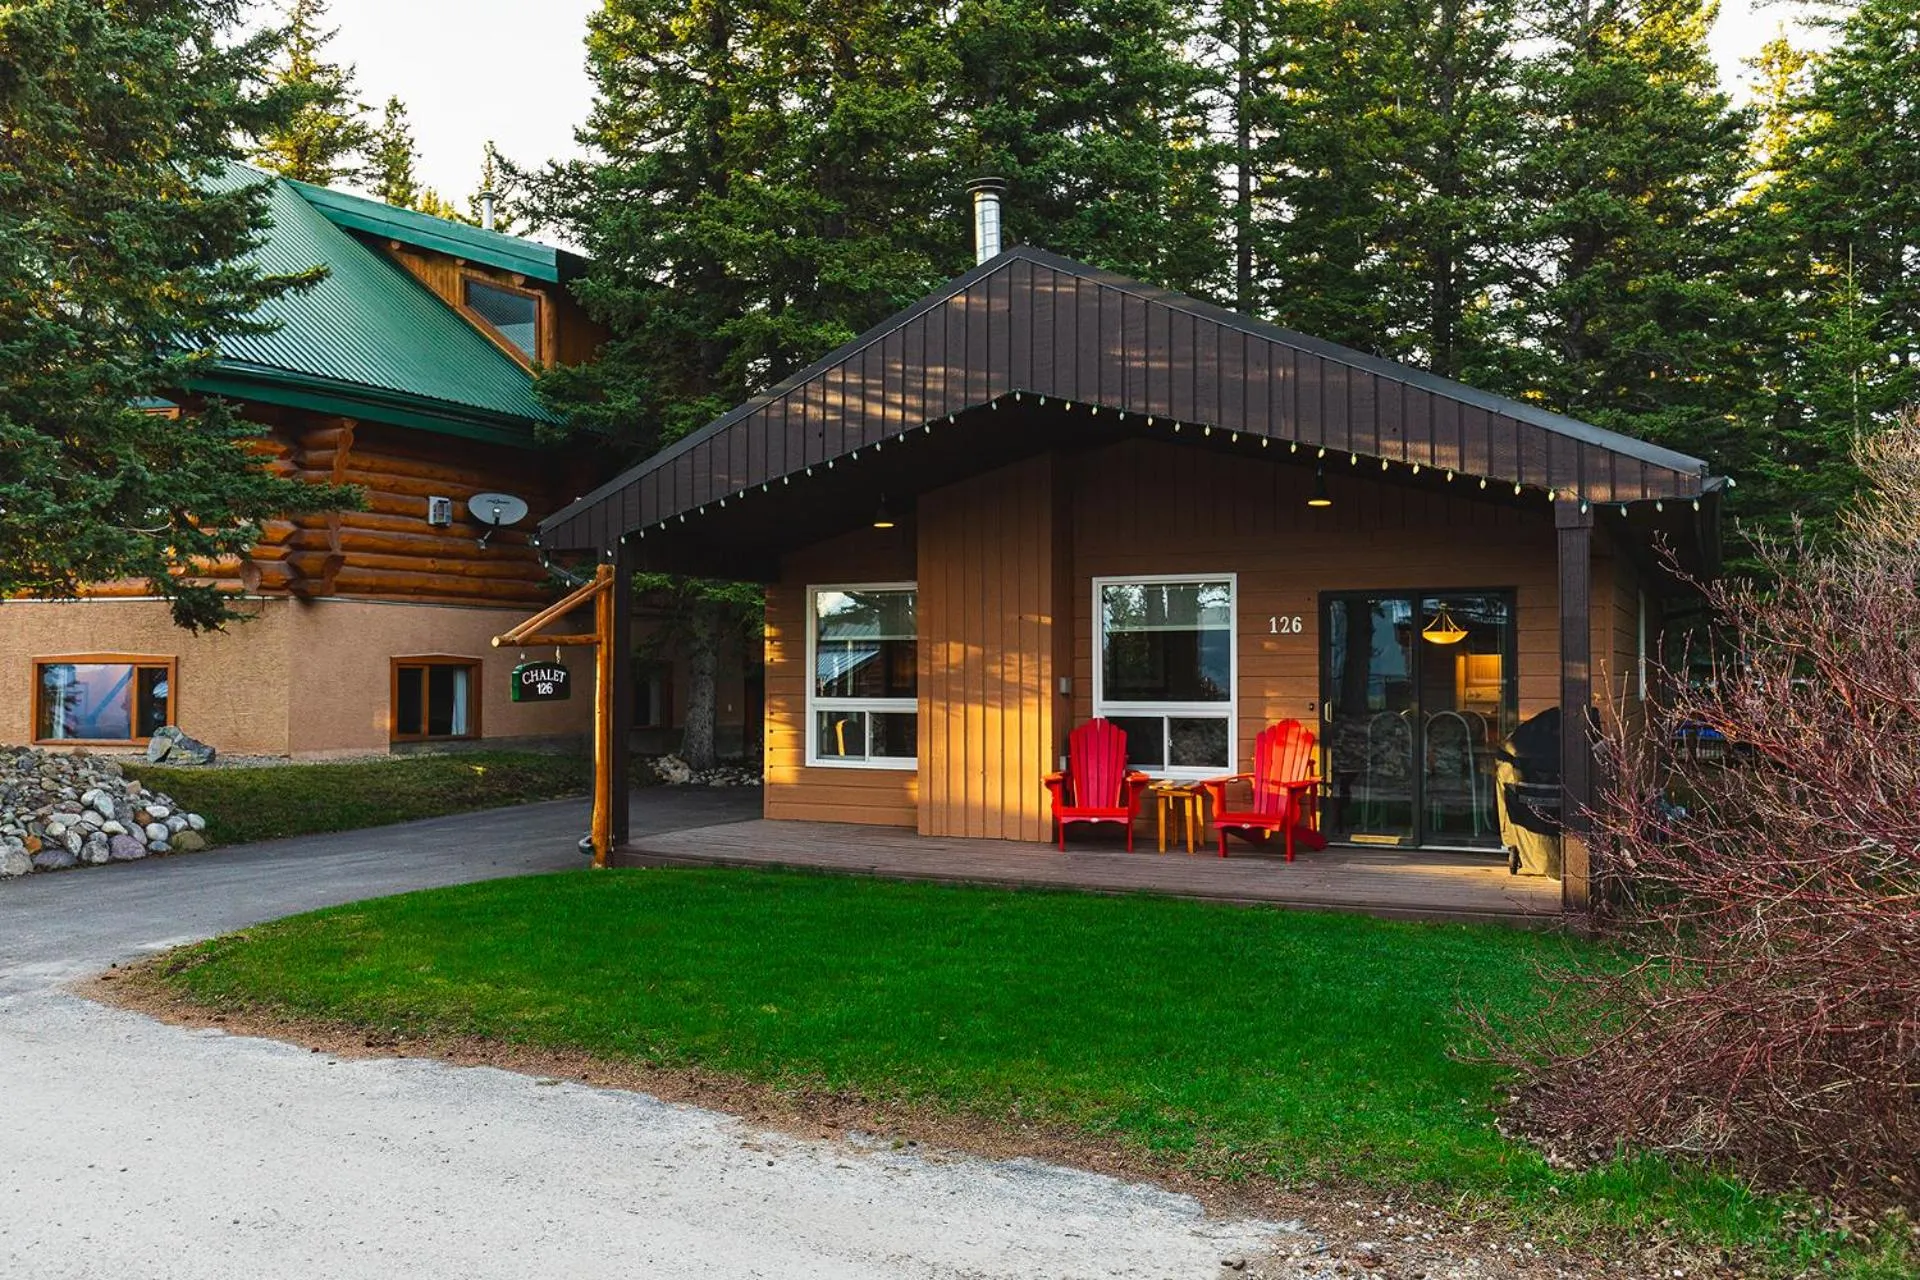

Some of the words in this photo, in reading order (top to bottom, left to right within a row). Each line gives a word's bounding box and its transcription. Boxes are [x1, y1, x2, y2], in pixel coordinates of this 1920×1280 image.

[1269, 616, 1302, 633] 126
[522, 669, 566, 684] CHALET
[537, 682, 553, 695] 126
